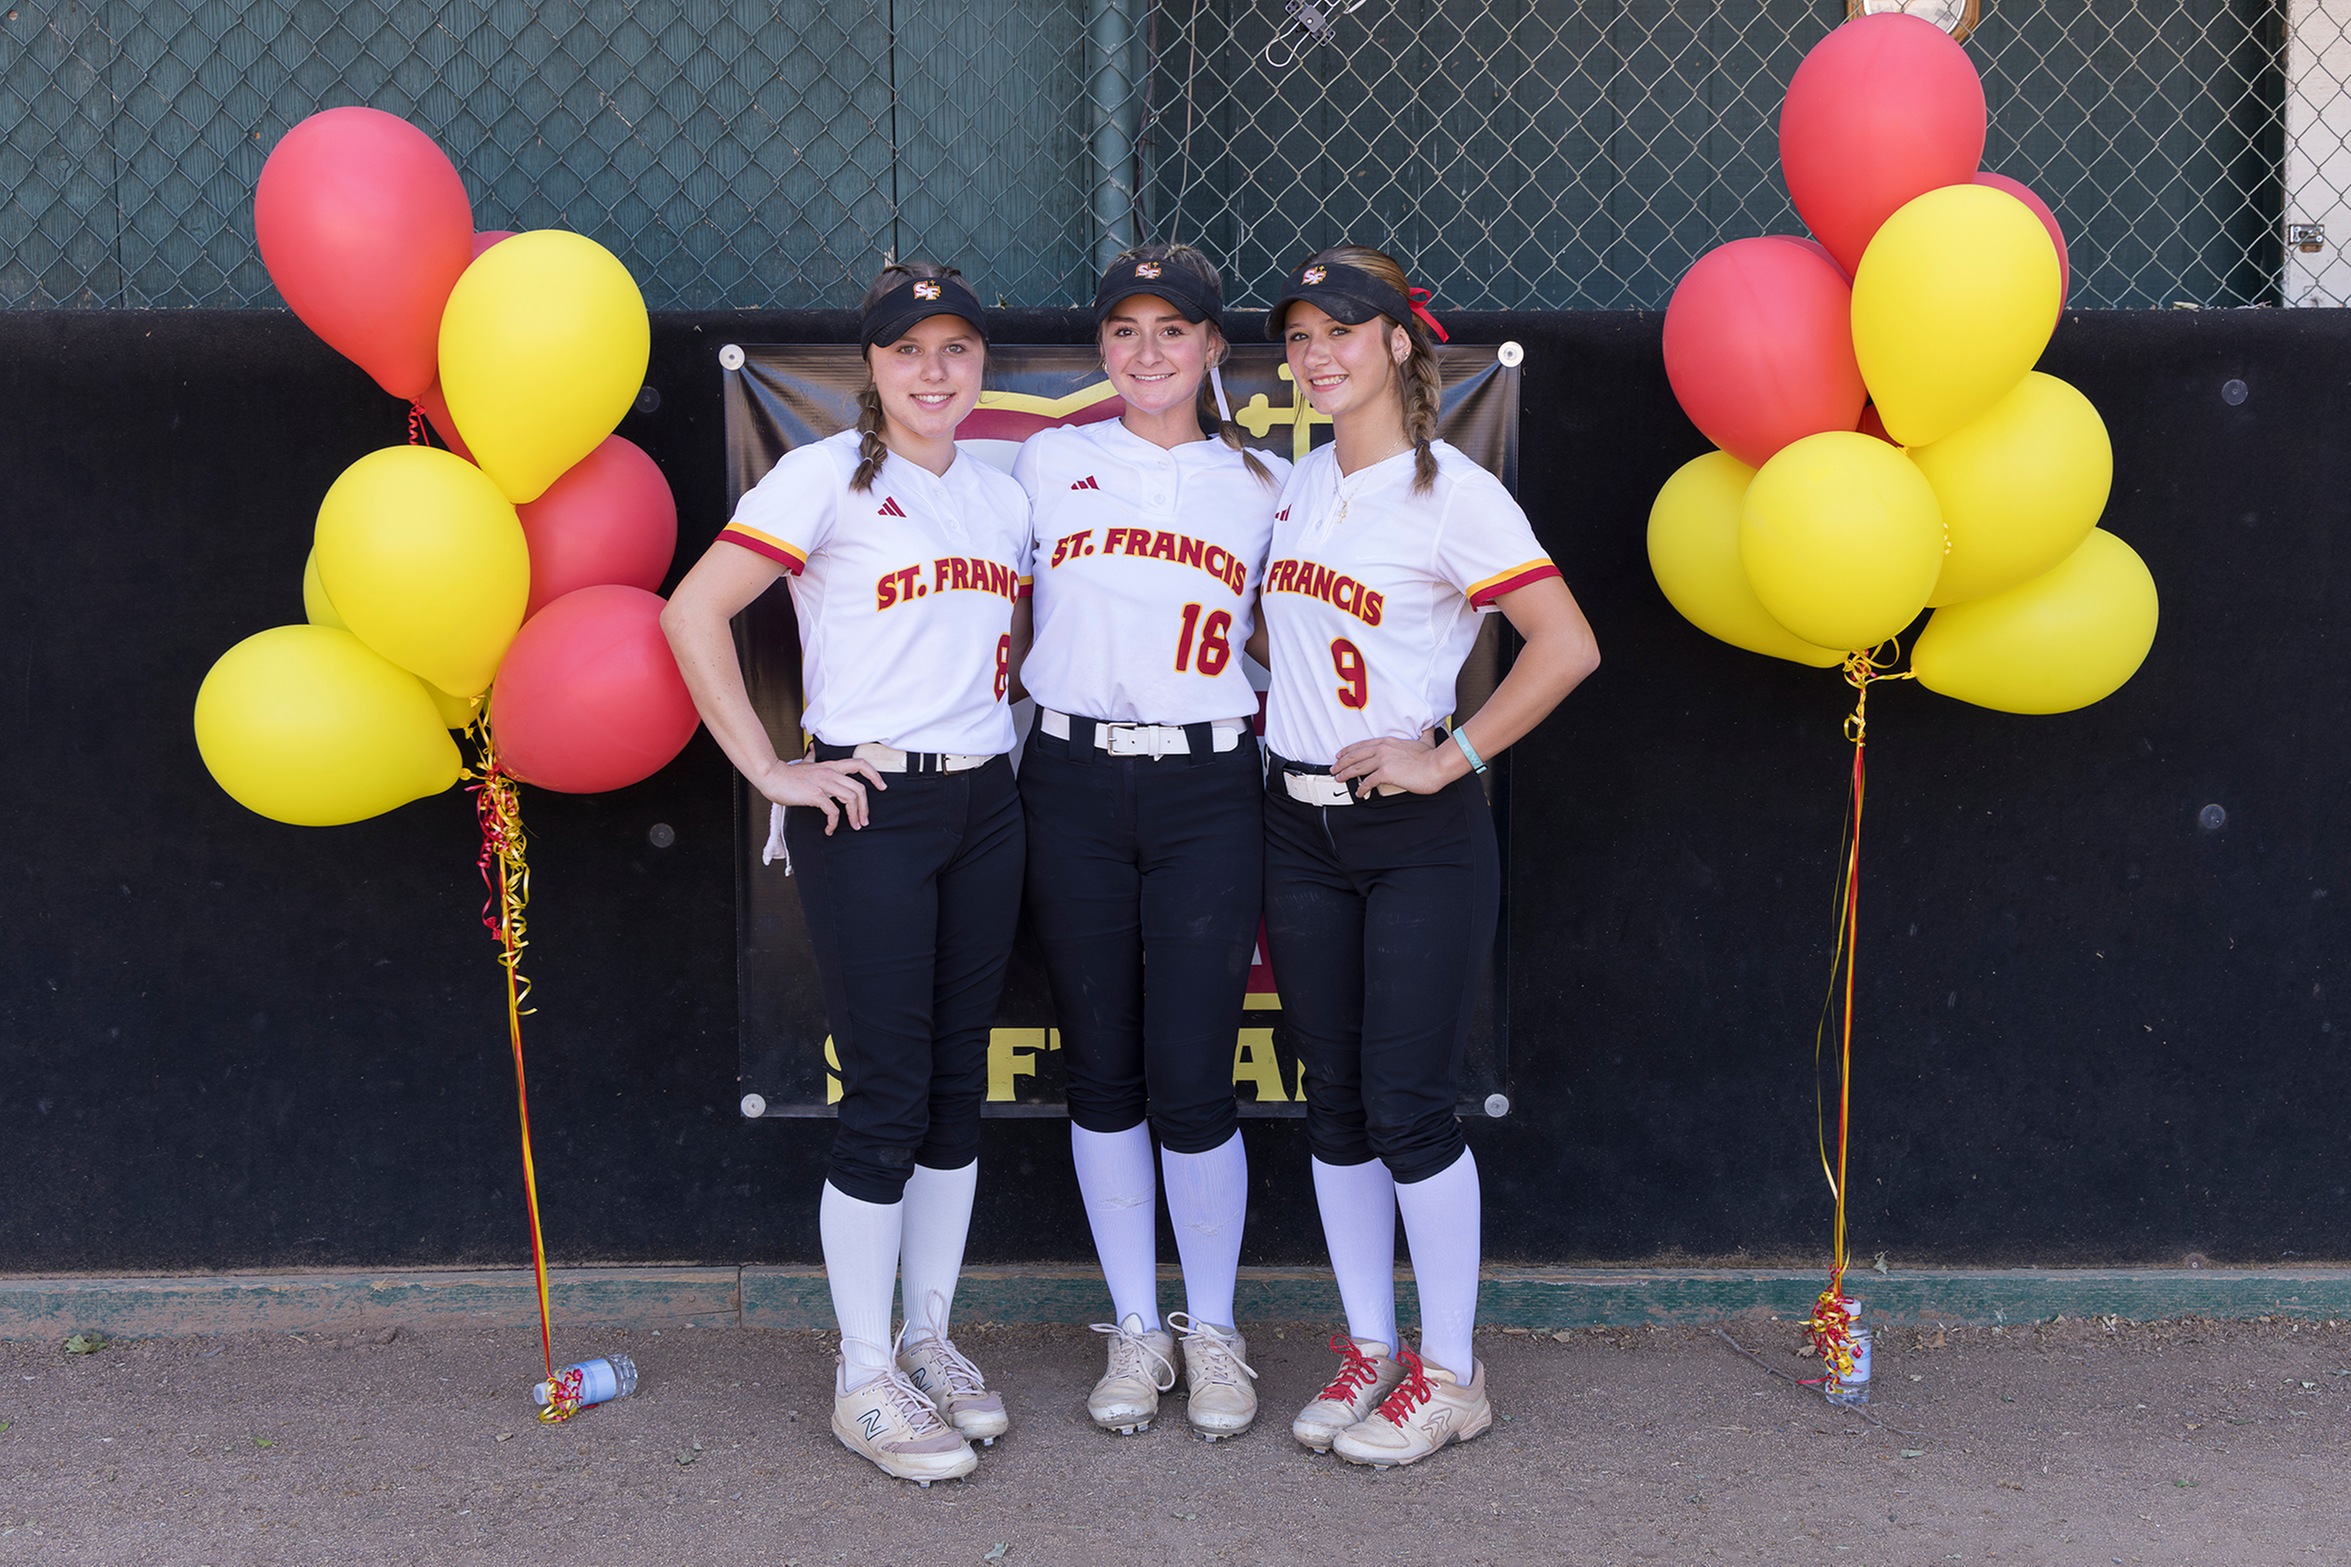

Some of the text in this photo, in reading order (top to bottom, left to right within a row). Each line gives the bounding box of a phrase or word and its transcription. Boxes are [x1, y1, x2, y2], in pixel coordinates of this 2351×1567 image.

[876, 563, 928, 612] ST.
[1051, 528, 1095, 571] ST.
[1101, 527, 1248, 597] FRANCIS
[1265, 559, 1386, 627] FRANCIS
[1330, 636, 1369, 712] 9
